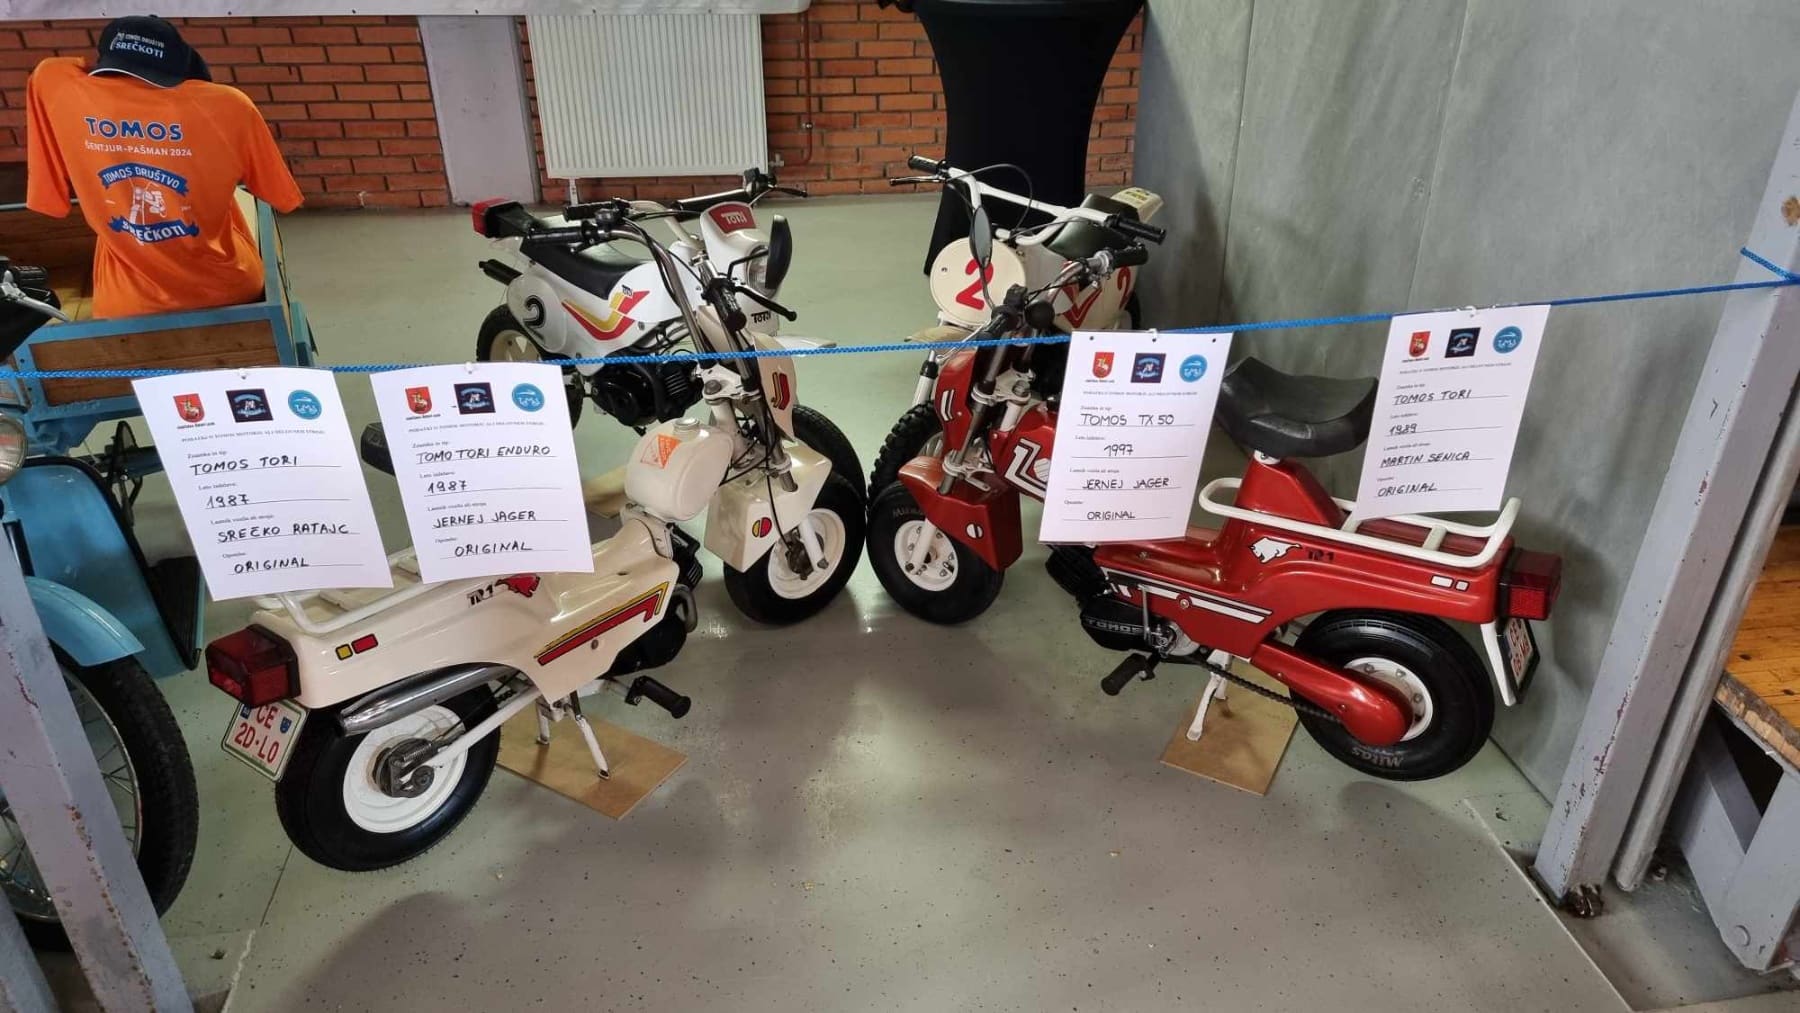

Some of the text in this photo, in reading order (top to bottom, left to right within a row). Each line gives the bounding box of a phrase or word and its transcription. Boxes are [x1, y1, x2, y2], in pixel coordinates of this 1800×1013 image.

[115, 41, 164, 58] SREČKOTI
[84, 116, 183, 141] TOMOS
[170, 148, 193, 157] 2024
[102, 166, 181, 190] TOMOS DRUŠTVO
[955, 257, 994, 311] 2
[1394, 389, 1472, 406] TOMOS TORI
[1080, 413, 1175, 426] TOMOS TX 50
[1389, 423, 1418, 436] 1989
[416, 445, 551, 465] TOMO TORI ENDURO
[1103, 443, 1134, 457] 1997
[190, 455, 298, 476] TOMOS TORI
[1380, 451, 1470, 469] MARTIN SENICA
[427, 479, 468, 494] 1987
[1082, 477, 1170, 490] JERNEJ JAGER
[1377, 482, 1438, 498] ORIGINAL
[206, 494, 249, 509] 1987
[432, 511, 537, 529] JERNEJ JAGER
[1086, 510, 1136, 521] ORIGINAL
[217, 523, 350, 543] SREČKO RATAJC
[454, 541, 534, 557] ORIGINAL
[234, 558, 310, 574] ORIGINAL
[256, 704, 279, 730] CE
